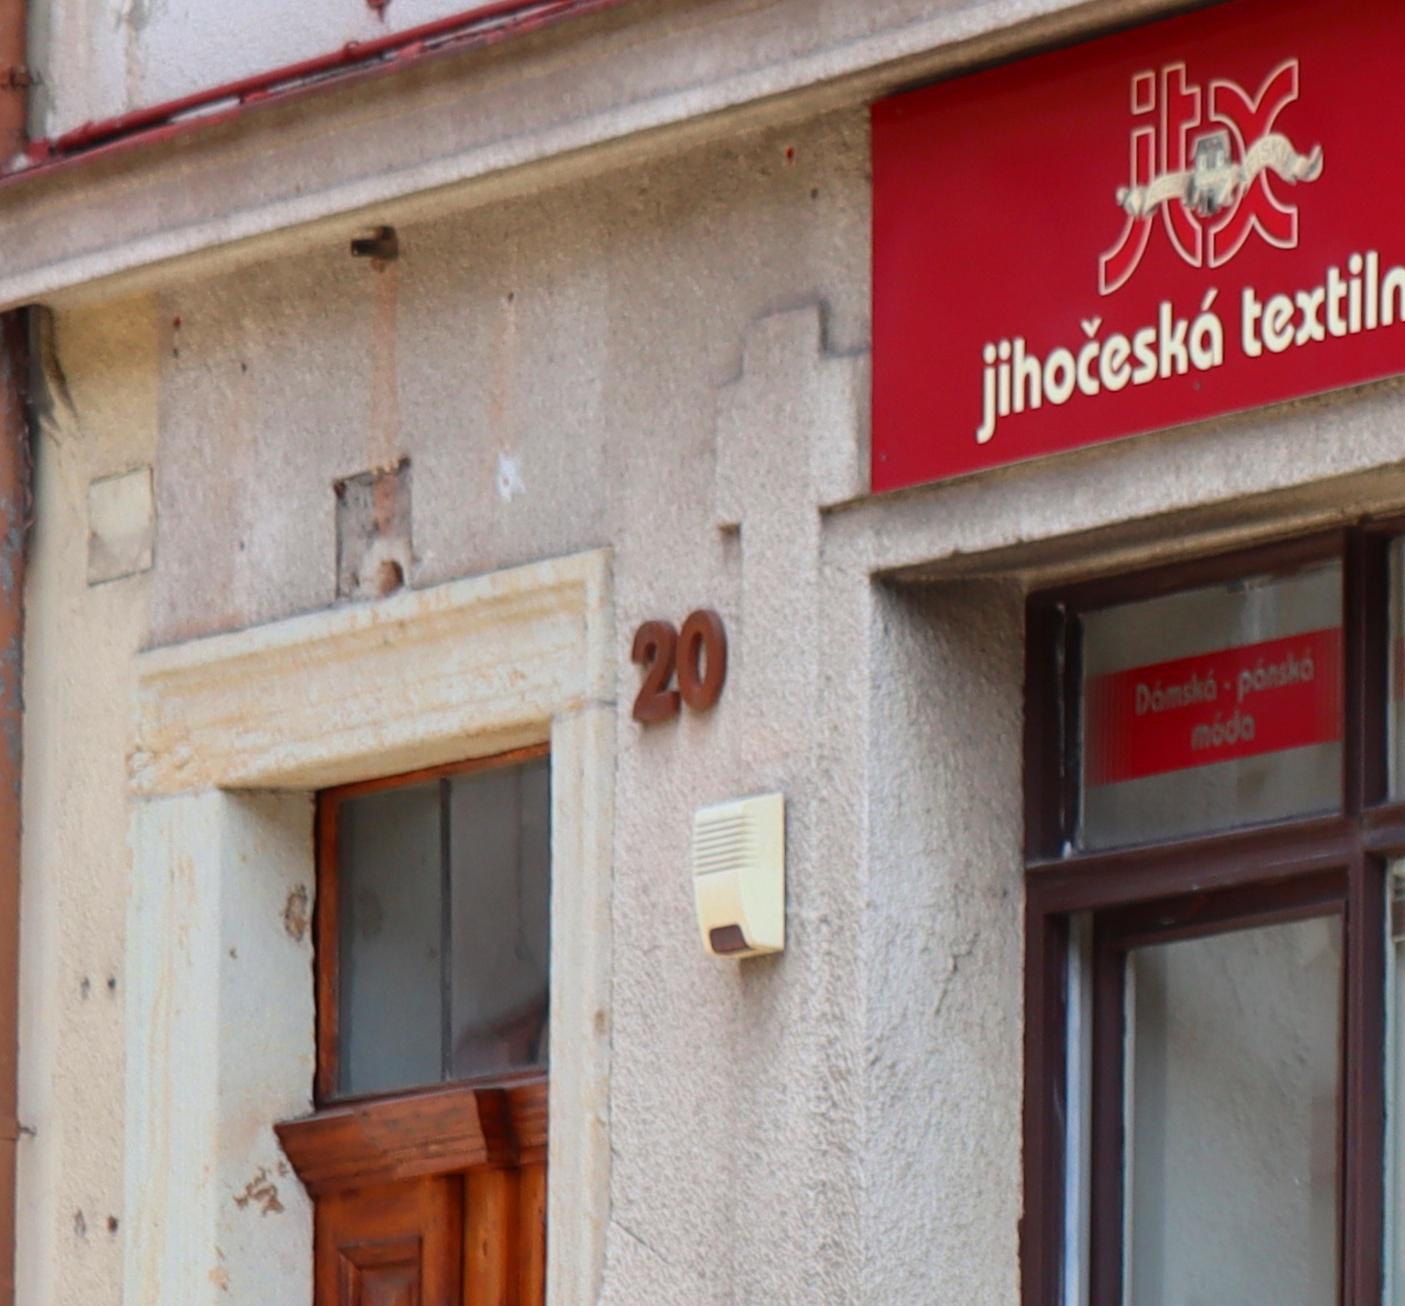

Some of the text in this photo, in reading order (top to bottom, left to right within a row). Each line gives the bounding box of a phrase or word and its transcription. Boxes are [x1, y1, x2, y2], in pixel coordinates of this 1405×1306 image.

[976, 287, 1224, 445] jihočeská
[630, 608, 728, 726] 20
[1135, 671, 1217, 717] Dámská
[1237, 648, 1314, 703] pánská
[1191, 710, 1255, 751] móda
